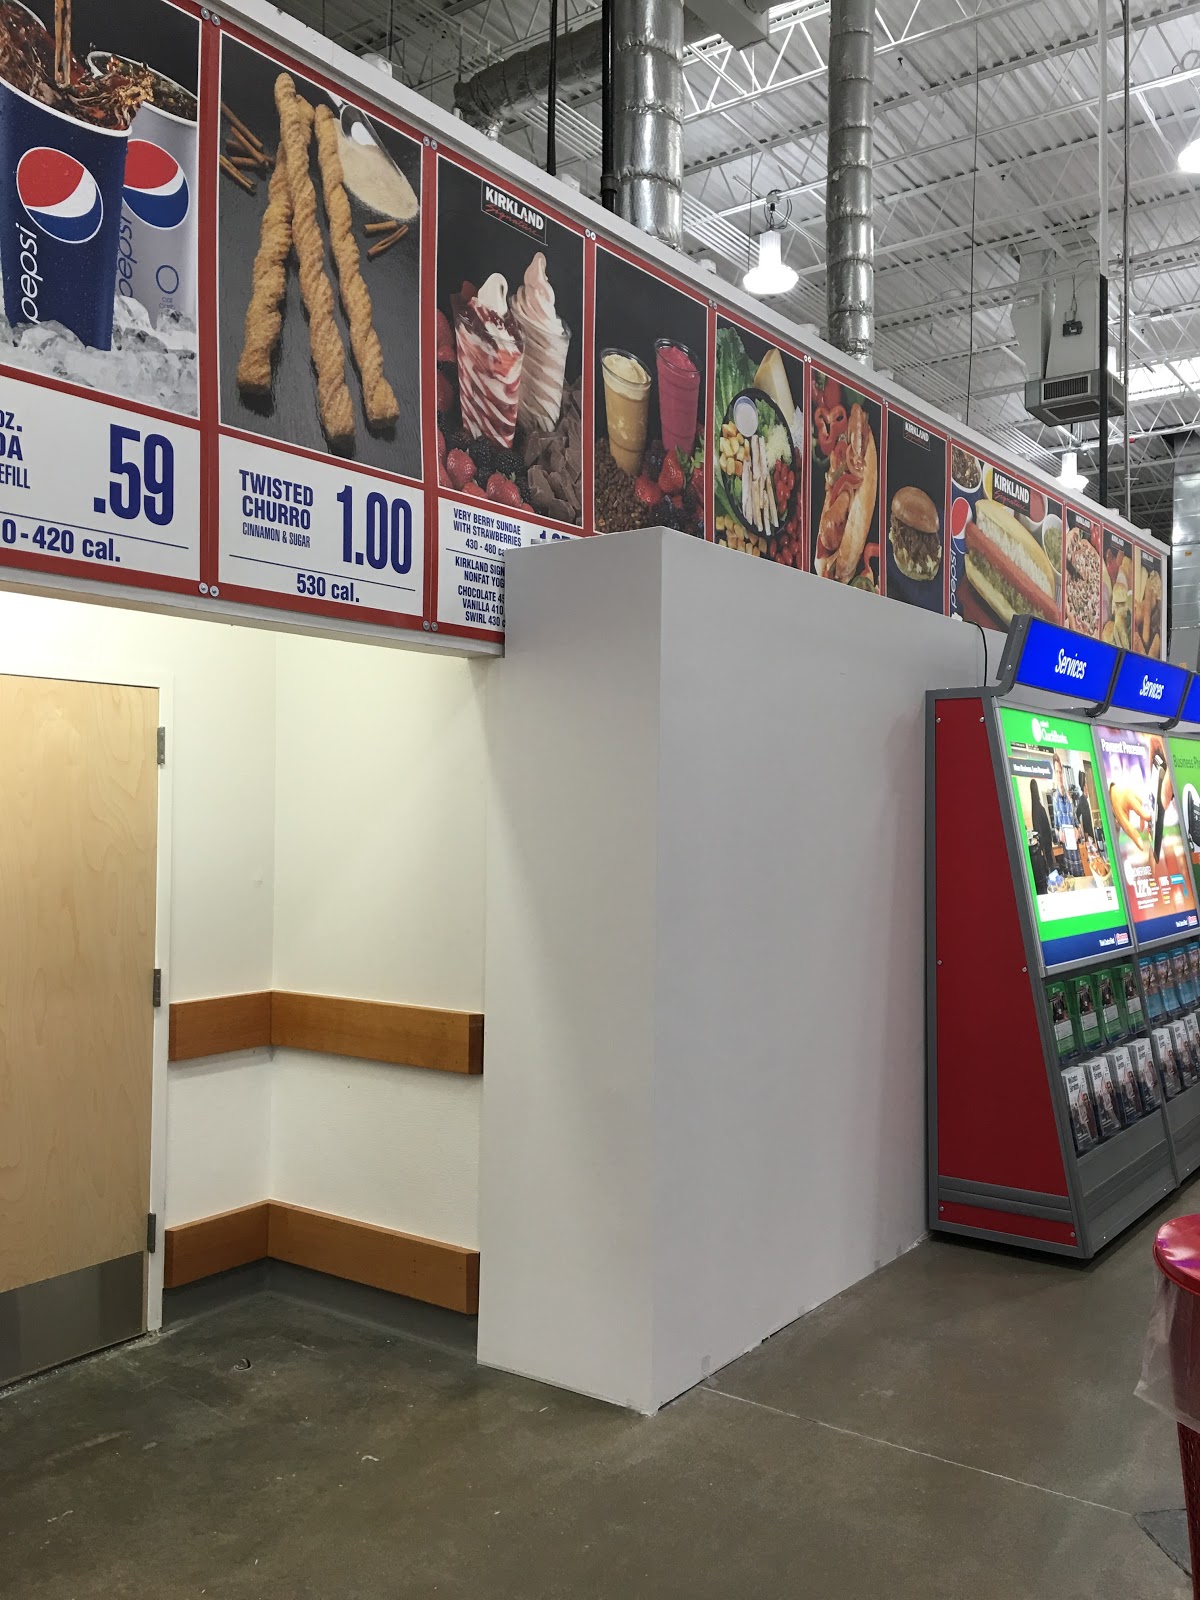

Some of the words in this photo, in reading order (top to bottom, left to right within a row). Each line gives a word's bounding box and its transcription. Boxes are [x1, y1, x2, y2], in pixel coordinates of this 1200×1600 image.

[485, 186, 544, 230] KIRKLAND
[15, 222, 43, 324] pepsi
[93, 422, 174, 526] .59
[239, 469, 314, 507] TWISTED
[994, 472, 1030, 504] KIRKLAND
[242, 495, 311, 530] CHURRO
[453, 507, 472, 520] VERY
[473, 513, 495, 529] BERRY
[496, 520, 521, 536] SUNDAE
[242, 521, 281, 543] CINNAMON
[282, 530, 288, 544] &
[289, 532, 311, 549] SUGAR
[336, 484, 413, 575] 1.00
[453, 520, 471, 534] WITH
[472, 526, 522, 547] STRAWBERRIES
[82, 537, 121, 563] cal.
[465, 538, 479, 551] 430
[484, 542, 497, 556] 480
[497, 547, 507, 558] ca
[455, 556, 489, 574] KIRKLAND
[489, 565, 505, 578] SIGN
[463, 570, 490, 585] NONFAT
[491, 576, 505, 589] YOG
[949, 548, 958, 609] pepsi
[296, 572, 327, 597] 530
[331, 582, 360, 603] cal.
[457, 585, 497, 603] CHOCOLATE
[462, 598, 490, 613] VANILLA
[491, 604, 504, 616] 410
[465, 611, 487, 625] SWIRL
[487, 615, 501, 627] 430
[1054, 648, 1087, 680] Services
[1139, 674, 1165, 700] Services
